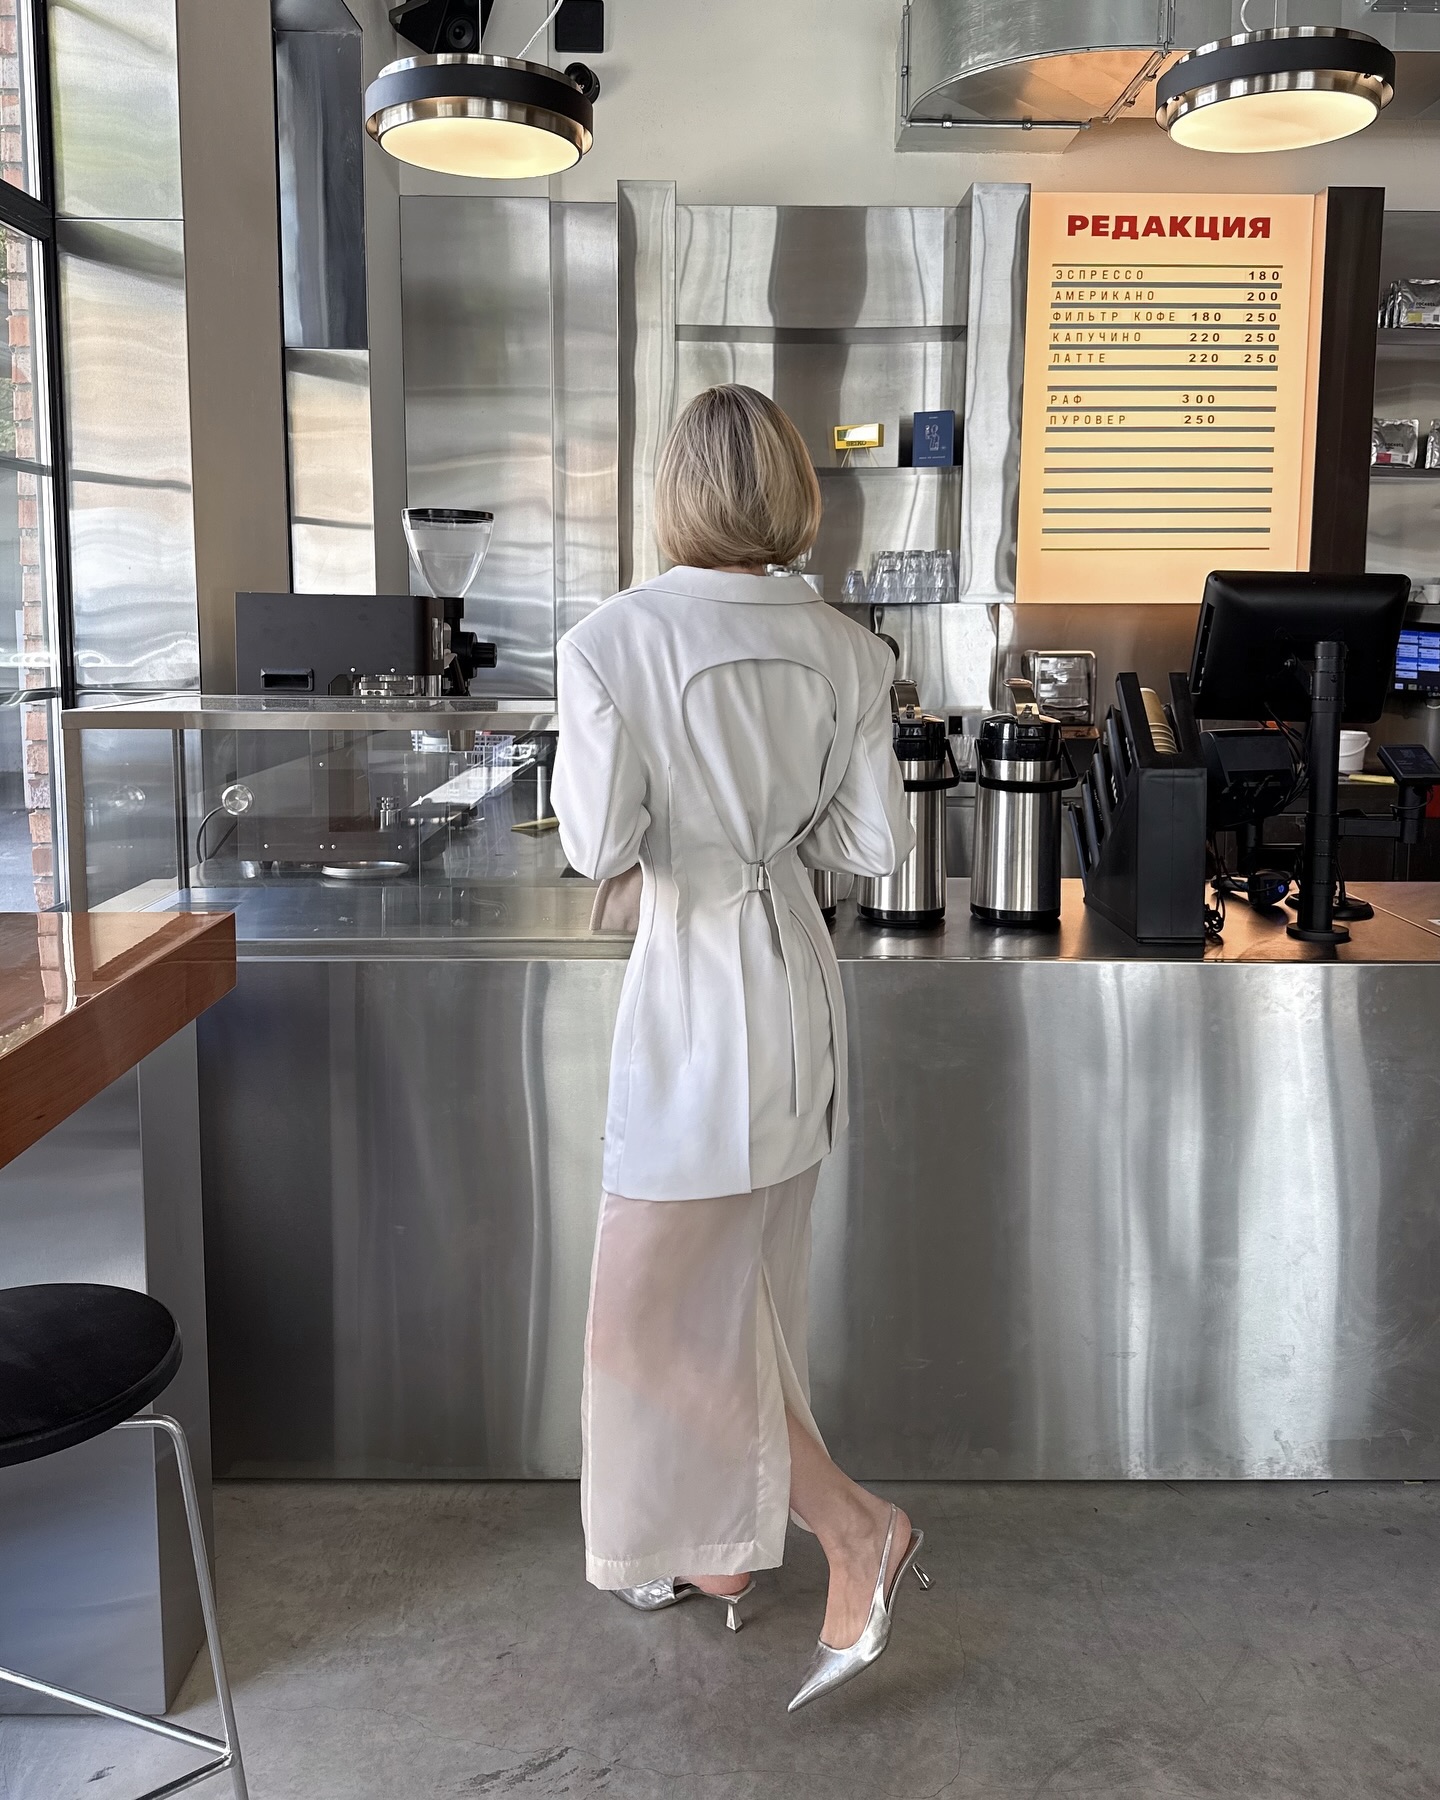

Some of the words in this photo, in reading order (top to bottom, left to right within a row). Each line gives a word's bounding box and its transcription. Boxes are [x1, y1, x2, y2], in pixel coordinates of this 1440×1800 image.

[1068, 215, 1271, 240] РЕДАКЦИЯ
[1055, 270, 1144, 280] ЭСПРЕССО
[1248, 271, 1280, 281] 180
[1055, 291, 1155, 301] АМЕРИКАНО
[1246, 292, 1278, 302] 200
[1052, 312, 1119, 322] ФИЛЬТР
[1134, 312, 1176, 322] КОФЕ
[1191, 312, 1222, 322] 180
[1245, 313, 1277, 322] 250
[1052, 332, 1141, 342] КАПУЧИНО
[1189, 333, 1220, 343] 220
[1244, 333, 1276, 343] 250
[1052, 353, 1106, 363] ЛАТТЕ
[1188, 353, 1219, 363] 220
[1243, 353, 1276, 364] 250
[1050, 394, 1082, 405] РАФ
[1181, 394, 1215, 404] 300
[1049, 414, 1126, 425] ПУРОВЕР
[1183, 415, 1215, 425] 250
